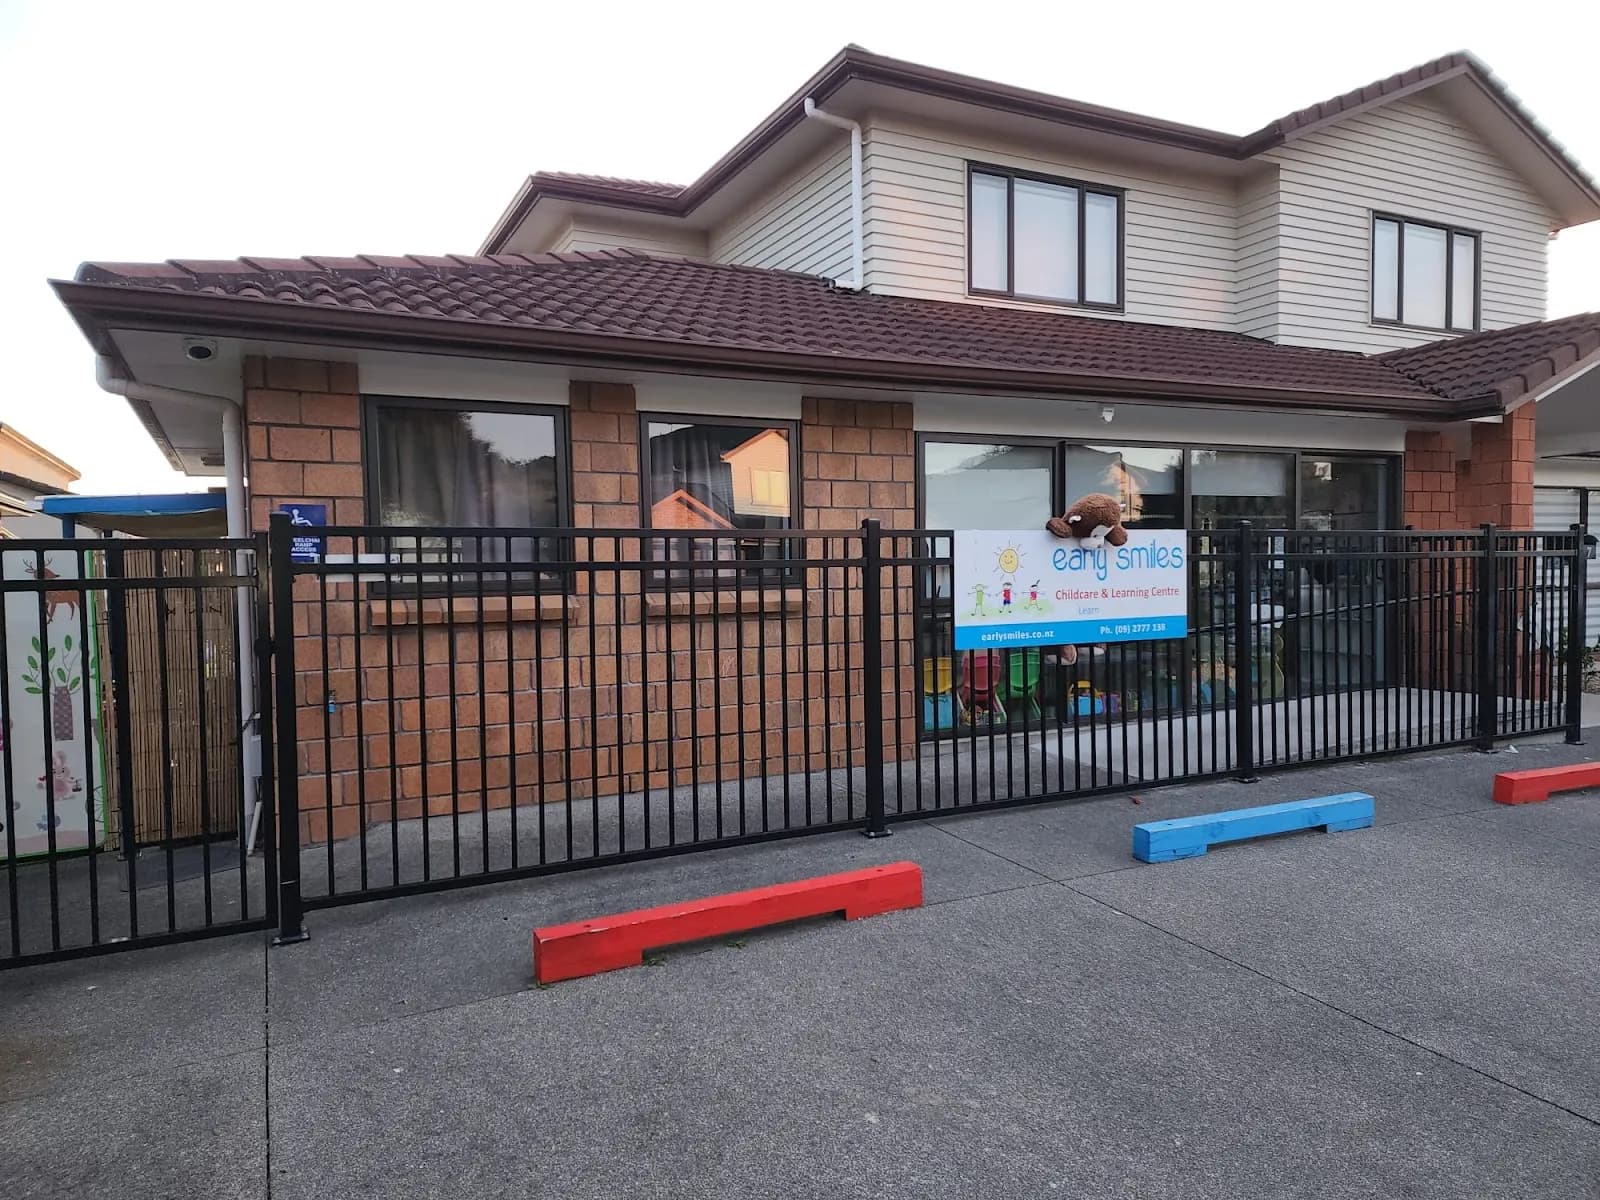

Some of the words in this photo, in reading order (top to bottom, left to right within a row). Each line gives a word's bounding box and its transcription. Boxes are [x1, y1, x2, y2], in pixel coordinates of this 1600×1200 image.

[1116, 539, 1184, 570] smiles
[1055, 589, 1099, 600] Childcare
[1101, 589, 1109, 599] &
[1111, 587, 1149, 599] Learning
[1151, 587, 1180, 597] Centre
[1100, 625, 1113, 634] Ph.
[1115, 625, 1130, 635] (09)
[981, 631, 1055, 642] earlysmiles.co.nz
